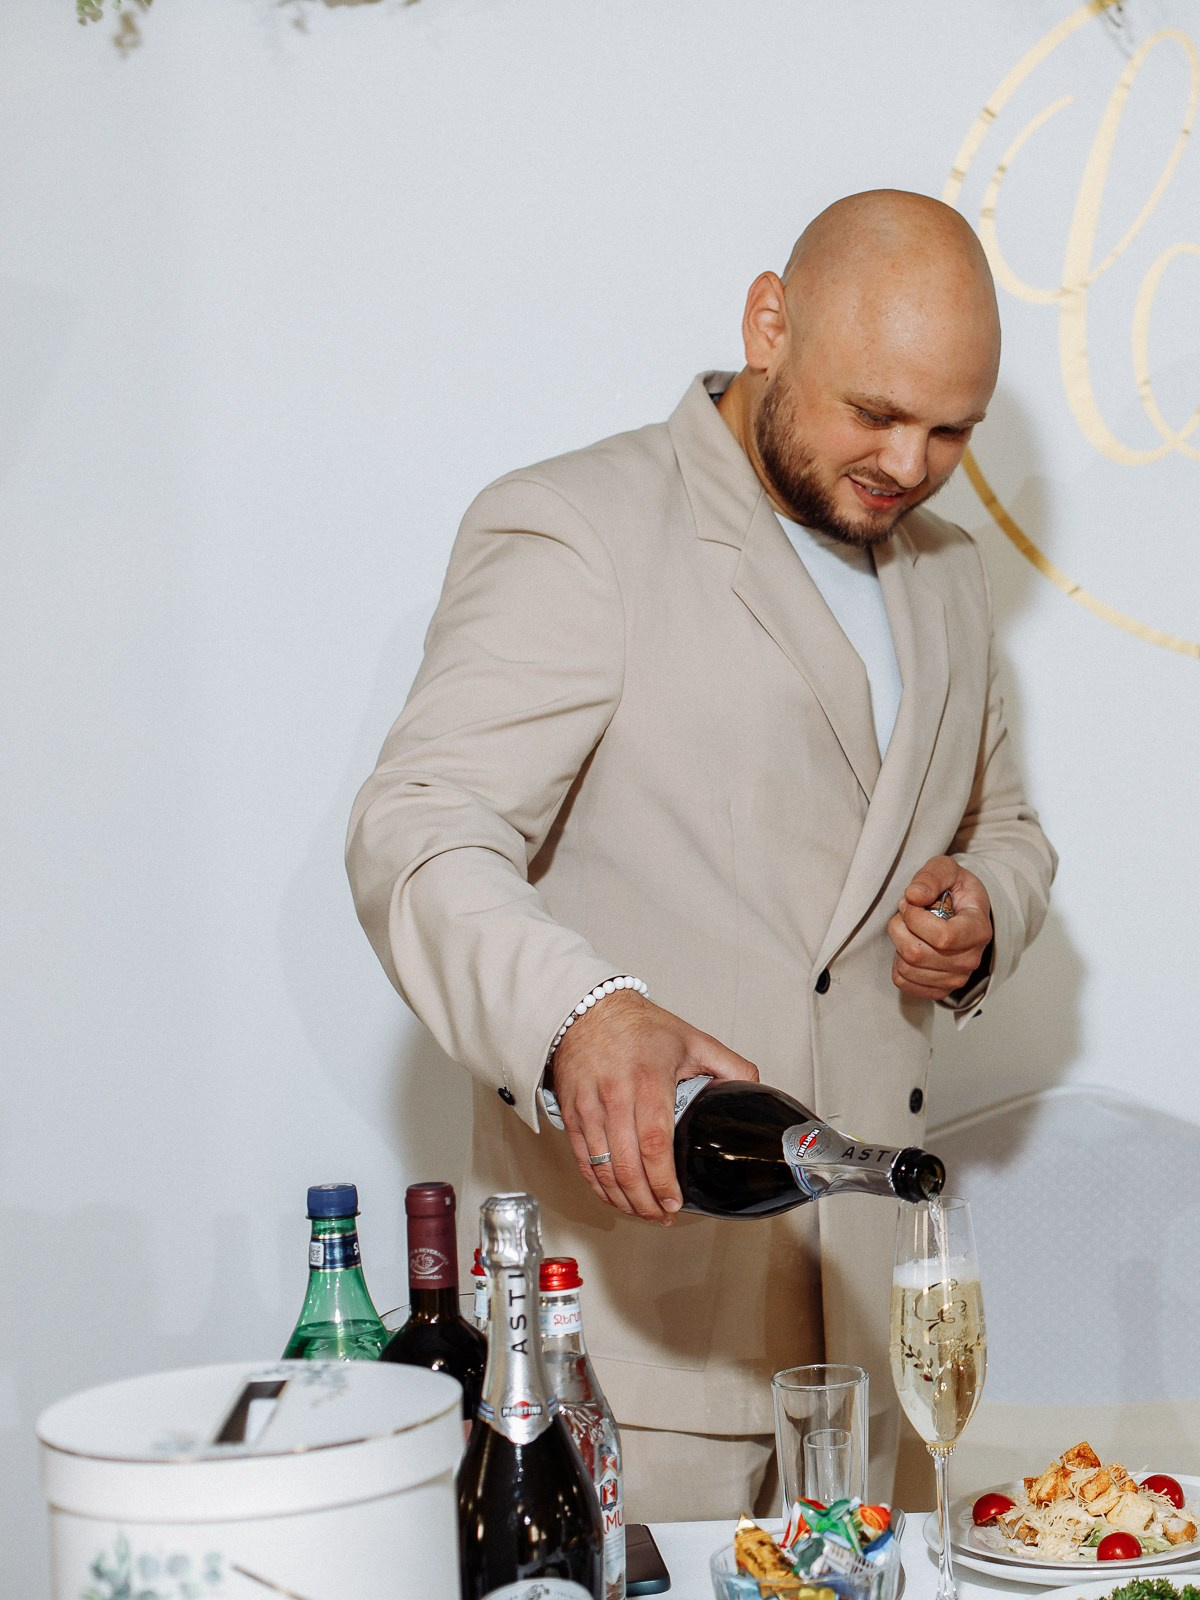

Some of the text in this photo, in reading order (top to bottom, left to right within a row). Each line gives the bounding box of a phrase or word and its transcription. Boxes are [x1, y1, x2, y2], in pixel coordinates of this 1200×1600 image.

[797, 1129, 820, 1157] MARTINI
[508, 1274, 528, 1355] ASTI
[502, 1405, 542, 1417] MARTINI
